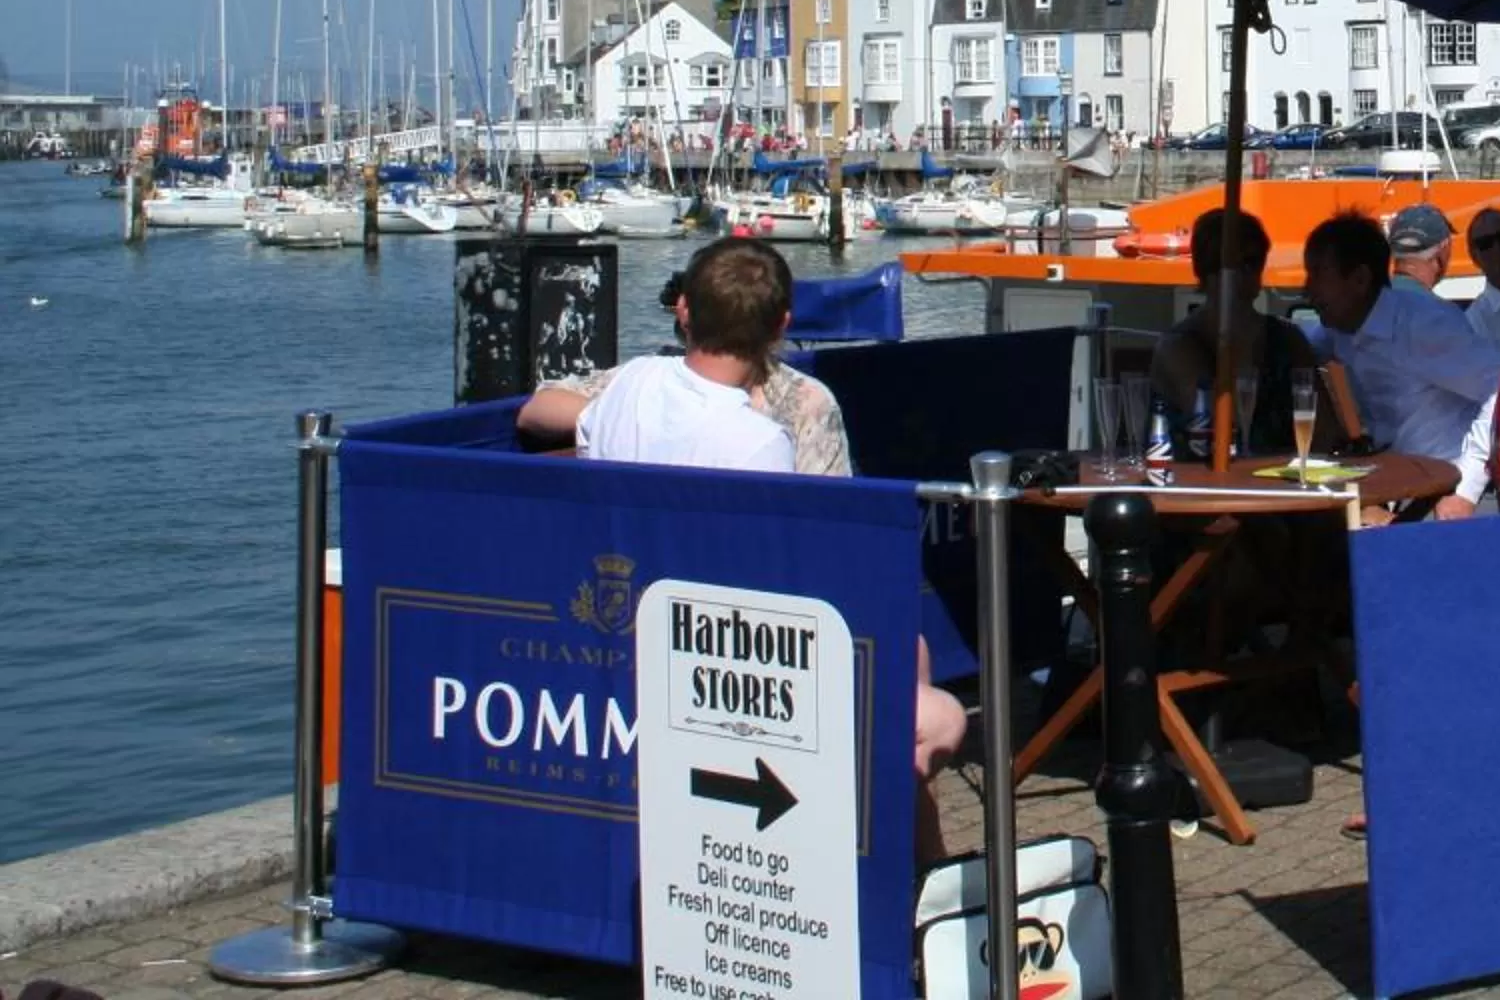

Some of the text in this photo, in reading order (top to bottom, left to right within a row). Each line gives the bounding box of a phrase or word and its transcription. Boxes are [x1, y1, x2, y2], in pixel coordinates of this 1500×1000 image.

[501, 637, 637, 671] CHAMP
[671, 601, 815, 671] Harbour
[691, 665, 794, 723] STORES
[701, 834, 789, 876] Food to go
[697, 862, 796, 903] Deli counter
[668, 884, 829, 939] Fresh local produce
[705, 921, 791, 960] Off licence
[655, 965, 687, 993] Free
[691, 976, 706, 997] to
[705, 949, 793, 989] Ice creams
